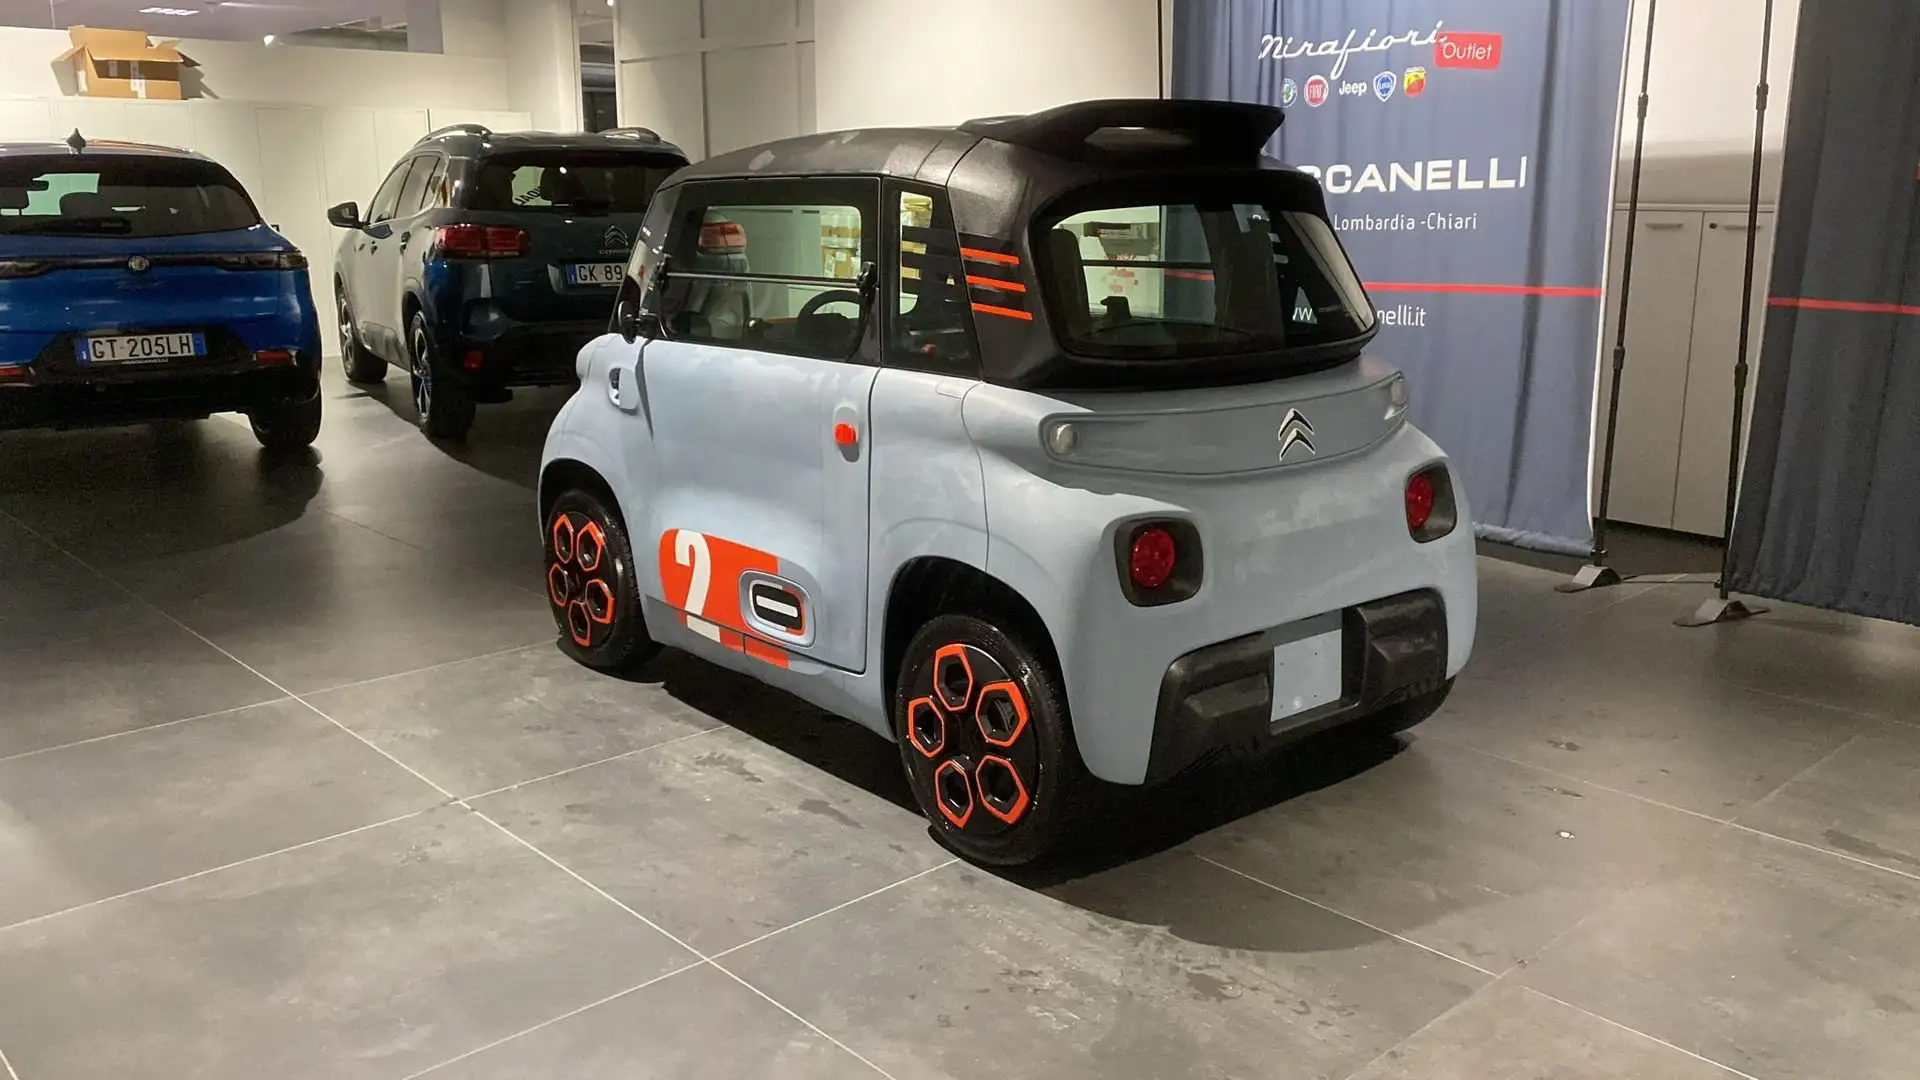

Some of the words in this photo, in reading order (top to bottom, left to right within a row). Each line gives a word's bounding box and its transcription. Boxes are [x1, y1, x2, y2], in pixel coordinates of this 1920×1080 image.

[1442, 42, 1493, 60] Outlet
[1339, 80, 1367, 96] Jeep
[1334, 214, 1415, 231] Lombardia
[579, 265, 598, 281] GK
[604, 264, 623, 281] 89
[1376, 304, 1427, 327] nelli.it
[91, 339, 117, 359] GT
[126, 335, 192, 357] 205LH
[675, 529, 721, 643] 2
